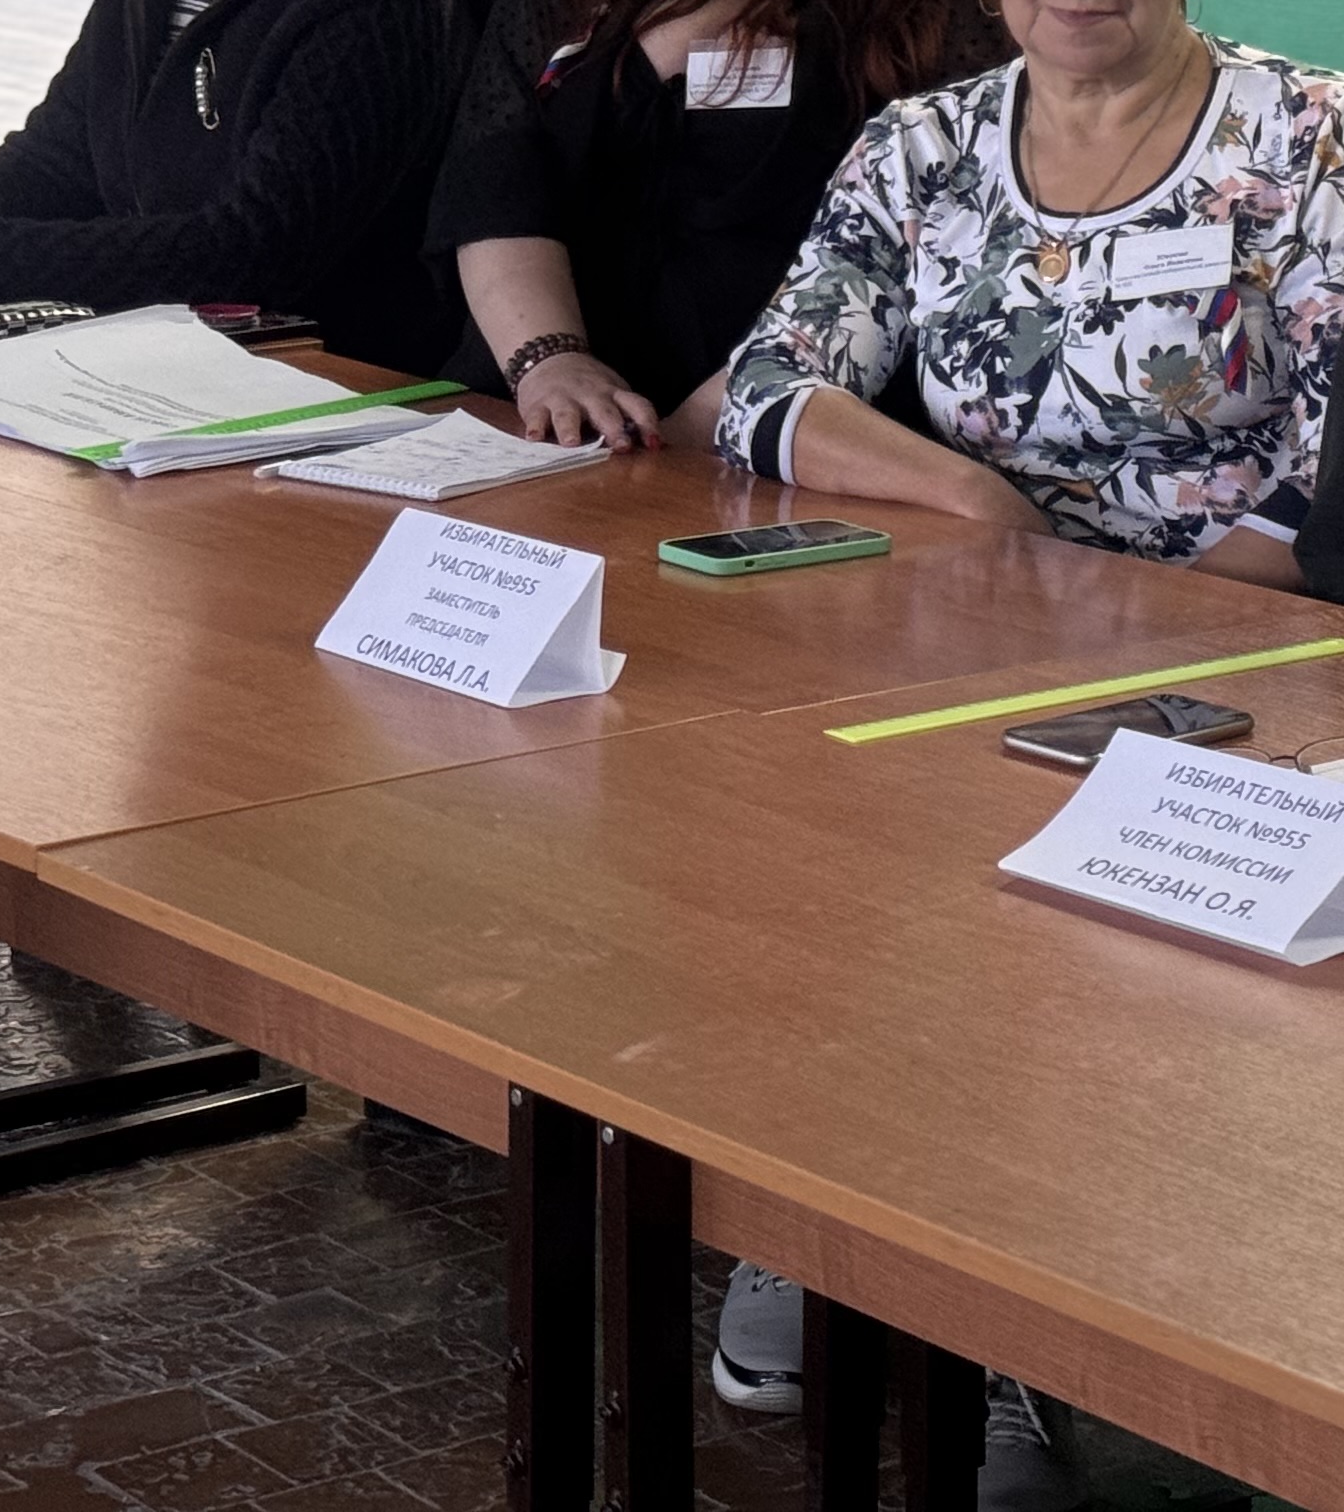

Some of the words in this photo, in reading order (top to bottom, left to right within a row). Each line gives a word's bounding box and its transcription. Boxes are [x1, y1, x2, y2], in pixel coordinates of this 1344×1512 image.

[439, 522, 568, 569] ИЗБИРАТЕЛЬНЫЙ
[427, 551, 494, 585] УЧАСТОК
[492, 568, 541, 597] №955
[424, 586, 501, 620] ЗАМЕСТИТЕЛЬ
[405, 612, 490, 647] ПРЕДСЕДАТЕЛЯ
[356, 633, 457, 682] СИМАКОВА
[454, 663, 490, 693] Л.А.
[1151, 795, 1246, 836] УЧАСТОК
[1244, 822, 1313, 851] №955
[1118, 825, 1177, 856] ЧЛЕН
[1169, 838, 1296, 886] КОМИССИИ
[1076, 855, 1208, 906] ЮКЕНЗАН
[1204, 891, 1260, 922] О.Я.
